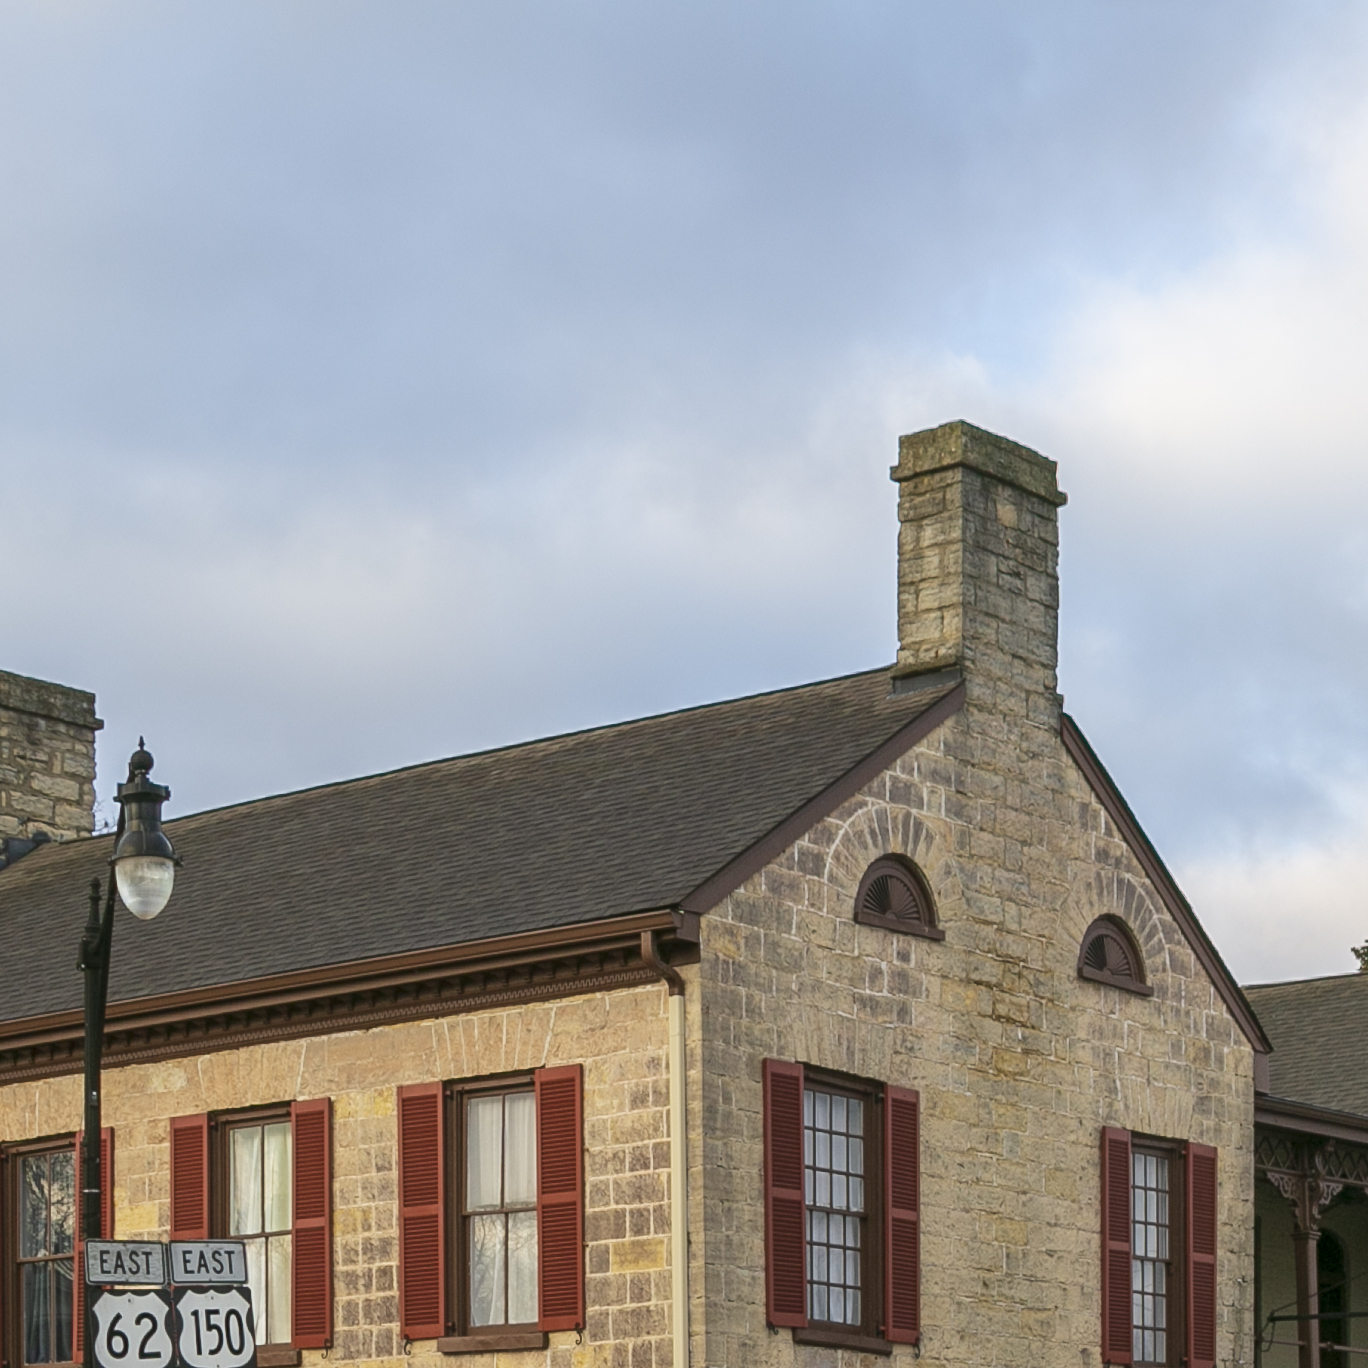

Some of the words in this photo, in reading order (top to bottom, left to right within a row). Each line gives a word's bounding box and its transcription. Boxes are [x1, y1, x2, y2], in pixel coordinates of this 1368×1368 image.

[99, 1250, 153, 1275] EAST
[182, 1250, 235, 1275] EAST
[106, 1311, 162, 1360] 62
[190, 1308, 246, 1356] 150
